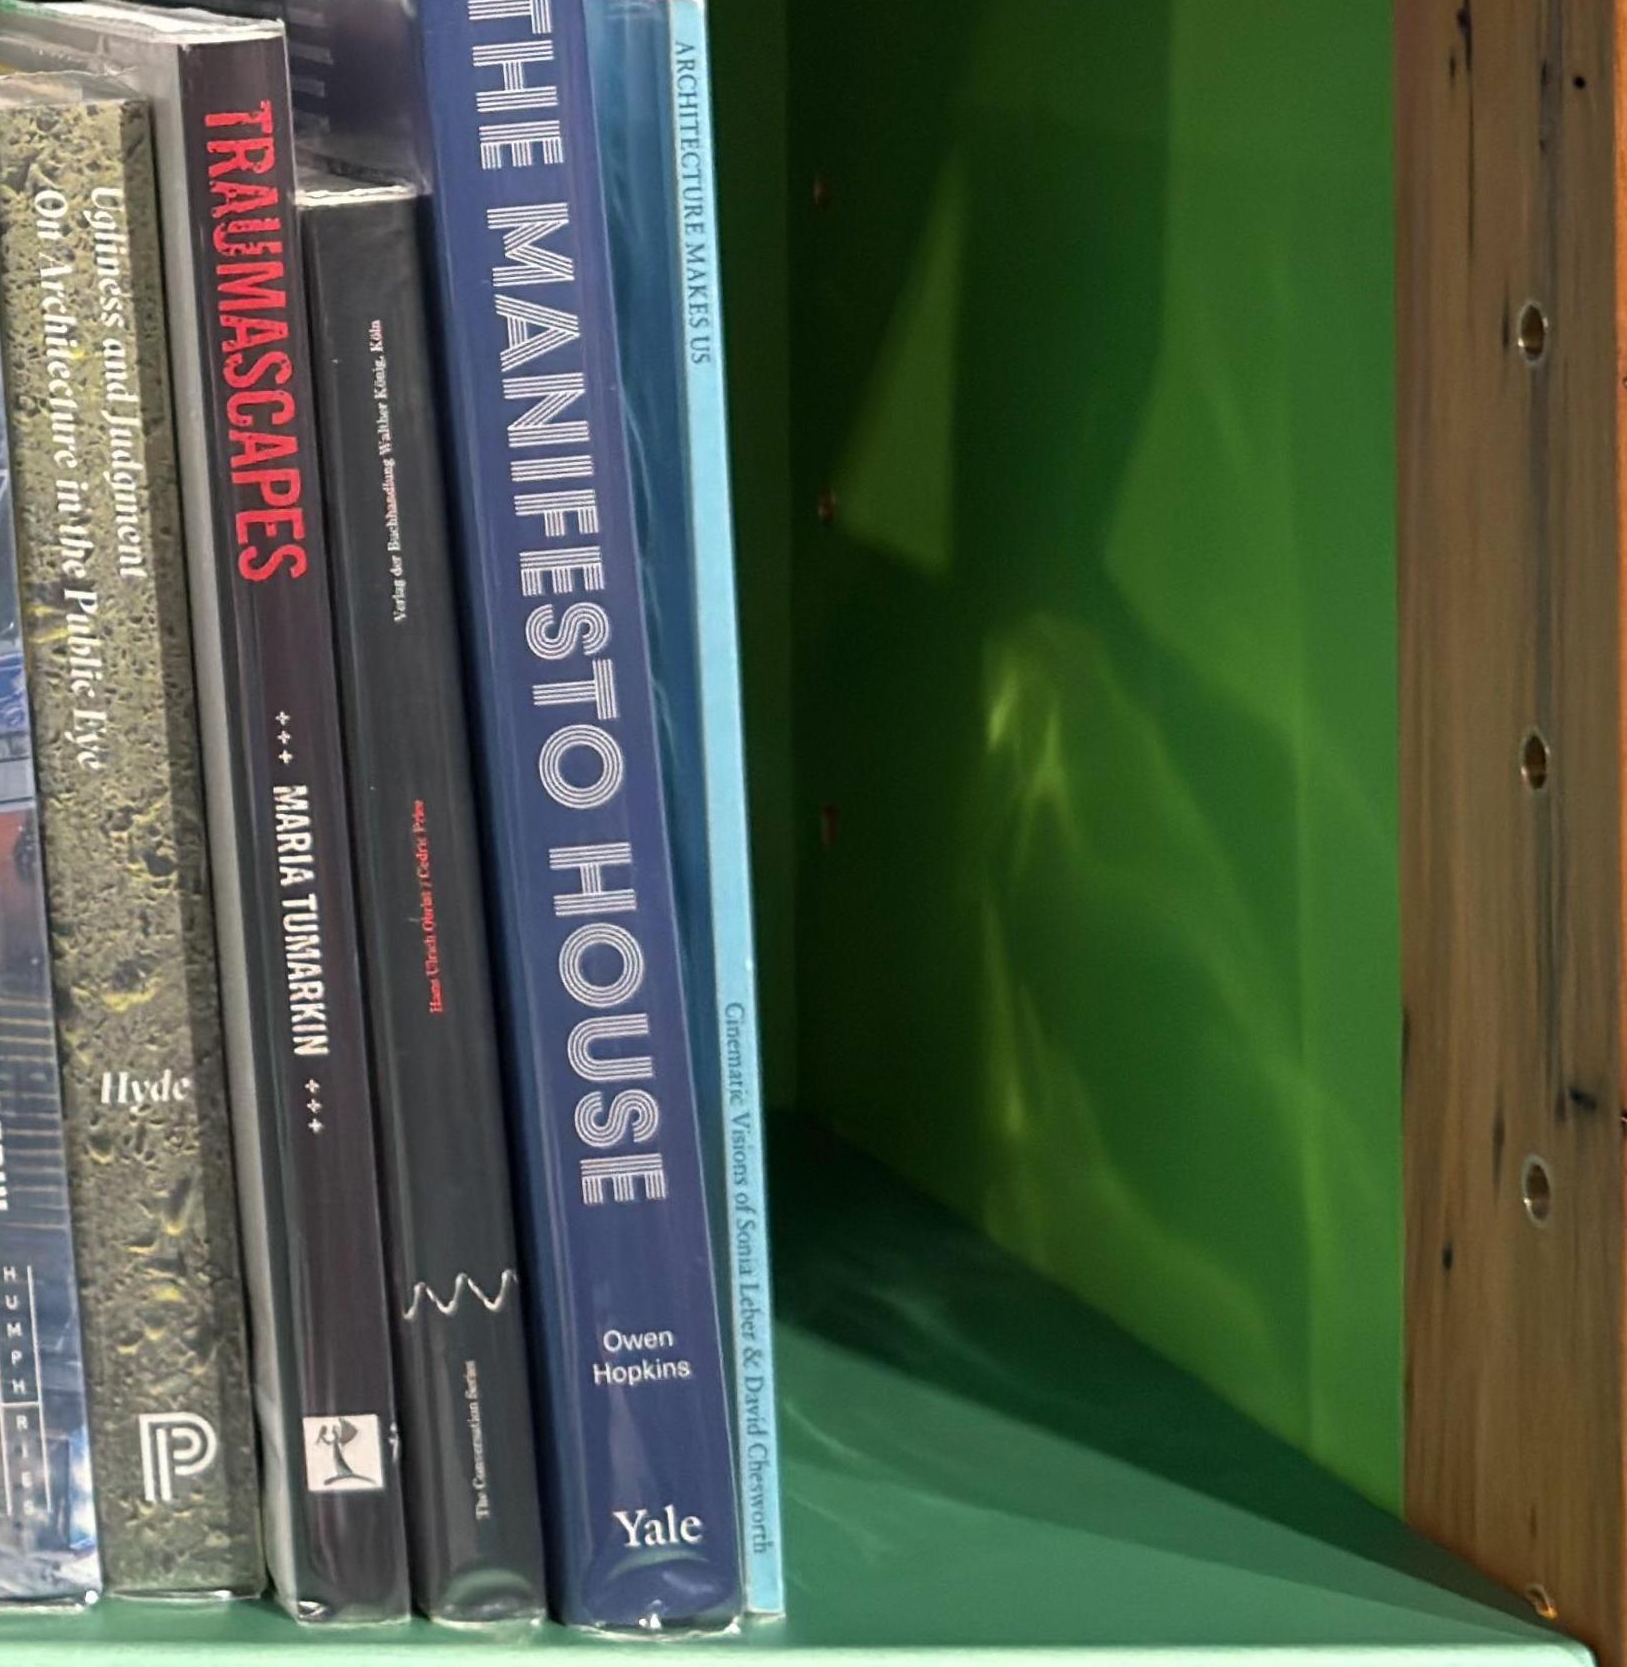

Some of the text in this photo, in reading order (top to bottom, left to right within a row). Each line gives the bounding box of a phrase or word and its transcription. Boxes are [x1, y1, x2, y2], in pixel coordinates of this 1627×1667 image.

[675, 40, 712, 366] ARCHITECTURE MAKES US
[83, 186, 147, 580] Ugliness and Judgment
[202, 100, 308, 582] TRAUMASCAPES
[369, 319, 384, 353] Köln
[376, 401, 392, 456] Walther
[33, 190, 107, 773] On Architecture in the Public Eye
[381, 458, 401, 552] Buchhandlung
[487, 203, 623, 809] MANIFESTO
[388, 554, 403, 577] der
[392, 579, 408, 622] Verlag
[272, 785, 331, 1058] MARIA TUMARKIN
[547, 842, 667, 1207] HOUSE
[100, 1069, 191, 1110] Hyde
[725, 1002, 773, 1555] Cinematic Visions of Sonia Leber & David Chesworth
[594, 1357, 690, 1385] Hopkins
[604, 1330, 674, 1354] Owen
[615, 1505, 704, 1547] Yale
